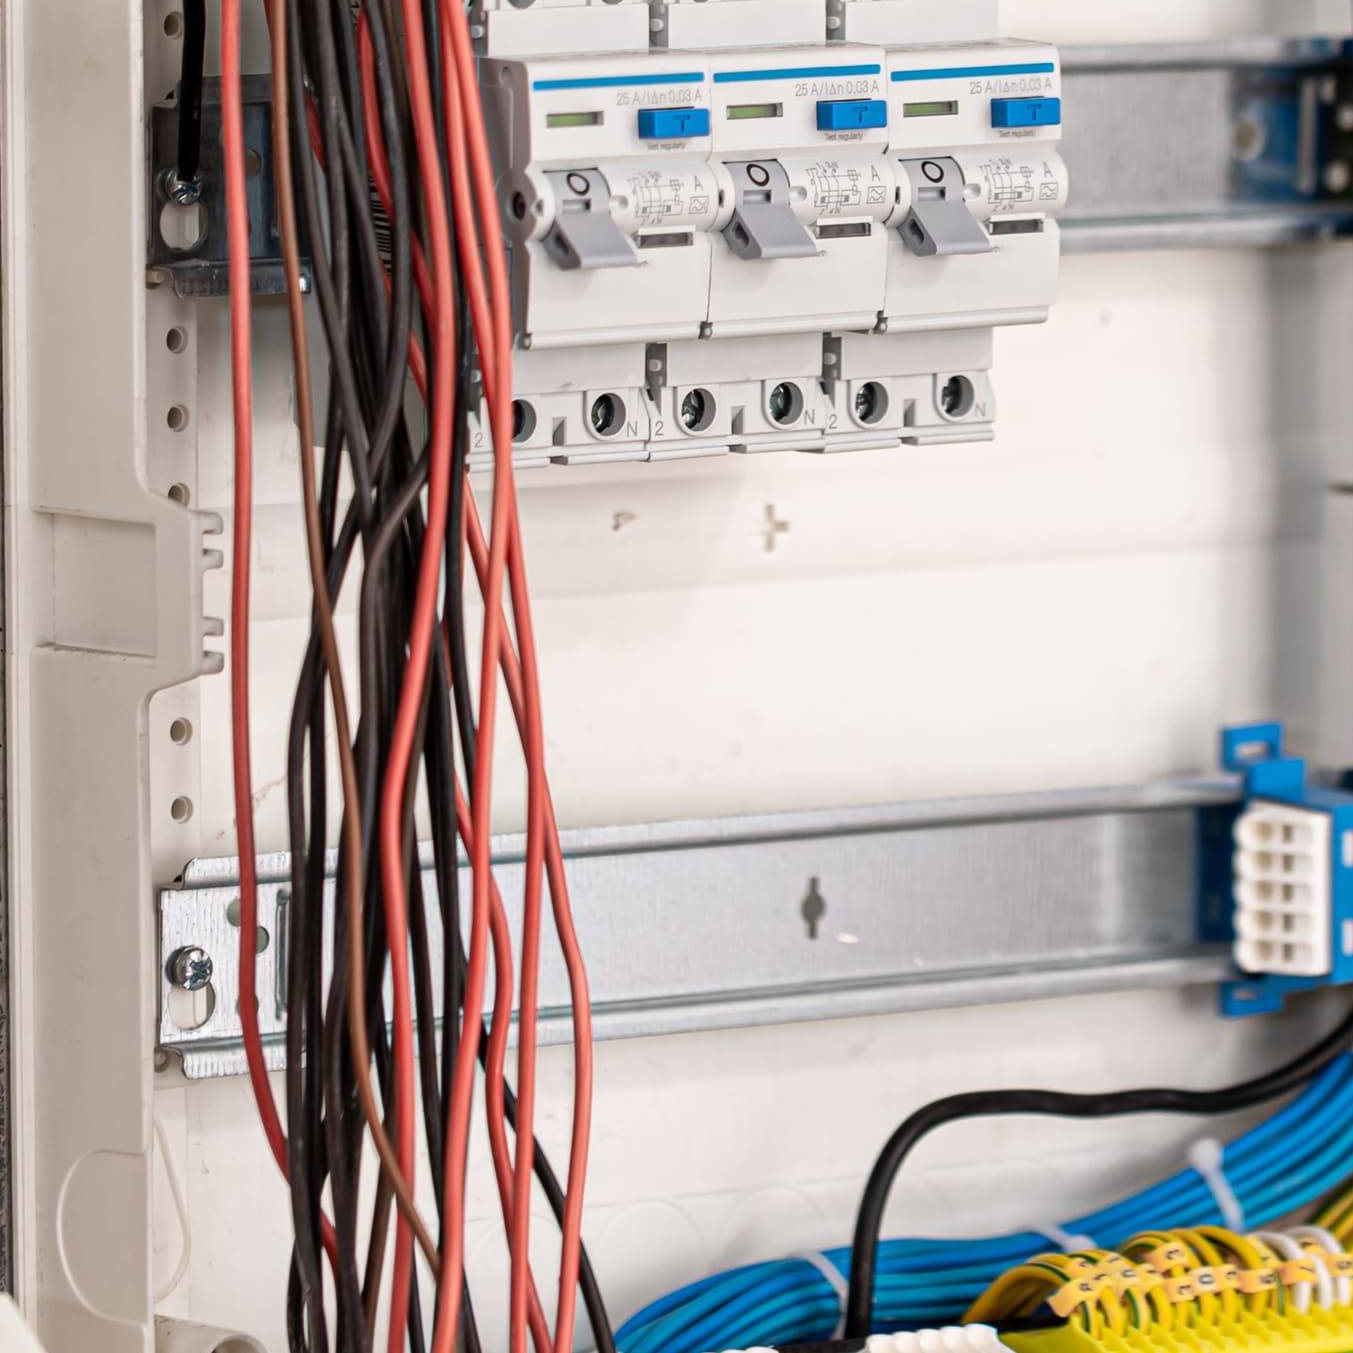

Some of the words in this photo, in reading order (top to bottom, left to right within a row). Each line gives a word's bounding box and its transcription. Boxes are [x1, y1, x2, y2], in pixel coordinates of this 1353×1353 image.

[795, 83, 808, 97] 25
[969, 81, 983, 95] 25
[616, 92, 630, 106] 25
[871, 165, 880, 182] A
[1043, 161, 1053, 178] A
[694, 175, 703, 192] A
[804, 409, 815, 425] N
[975, 403, 986, 417] N
[627, 421, 638, 436] N
[654, 420, 664, 436] 2
[828, 414, 838, 430] 2
[474, 432, 484, 448] 2
